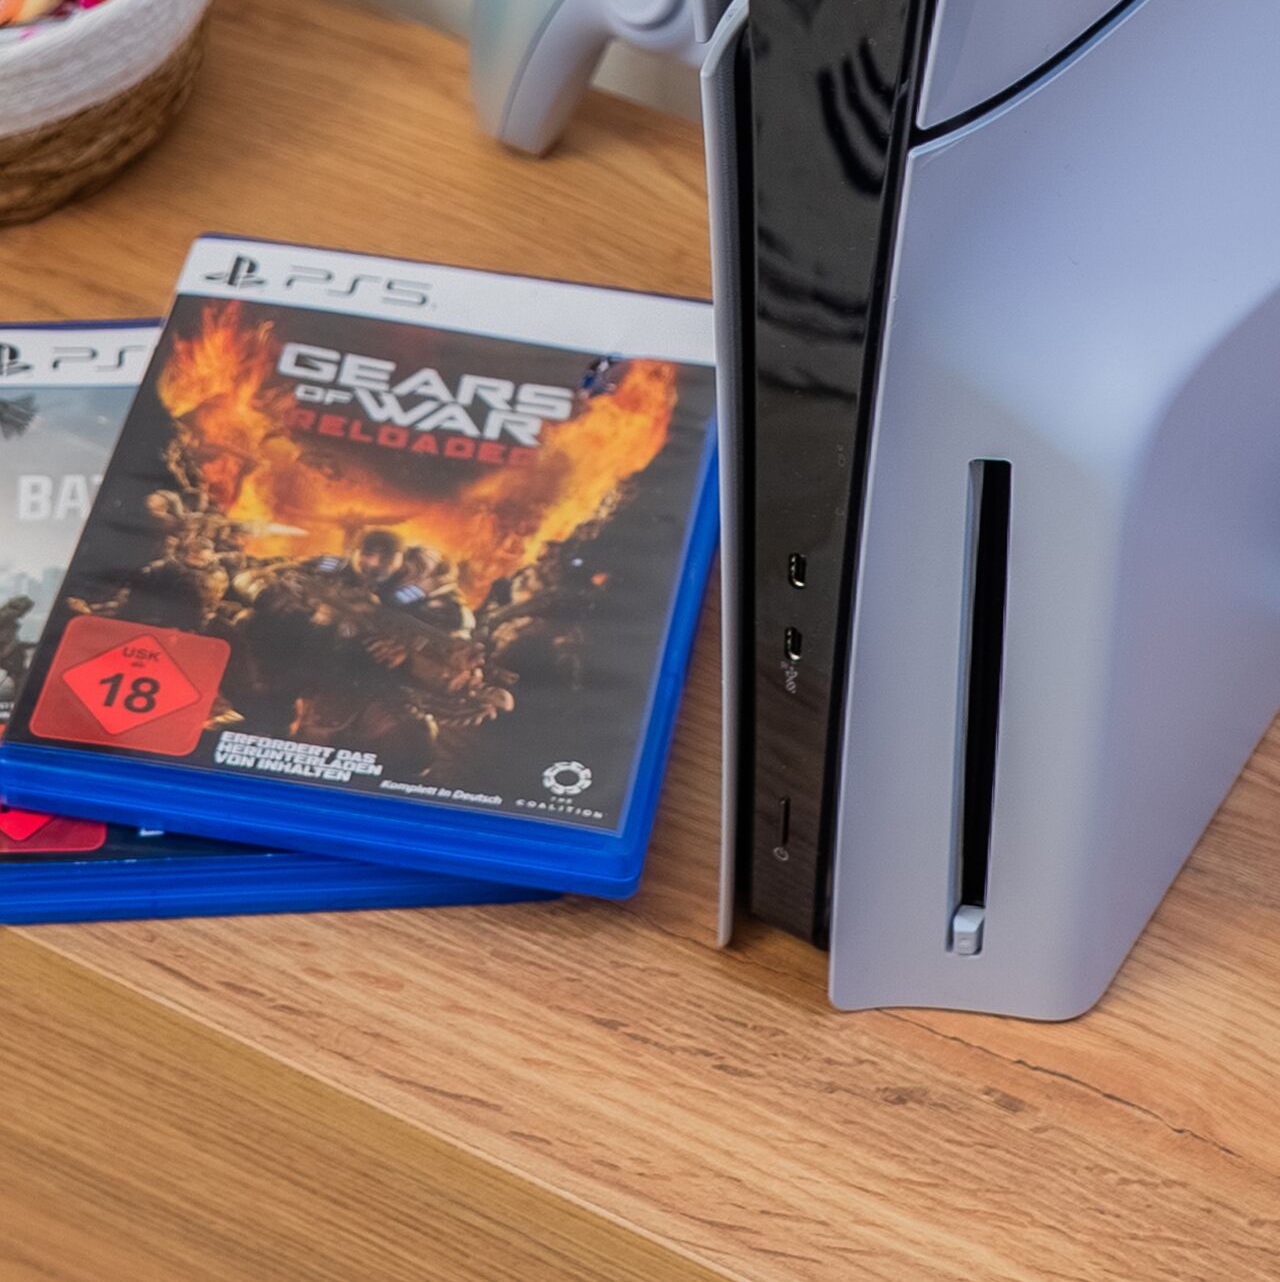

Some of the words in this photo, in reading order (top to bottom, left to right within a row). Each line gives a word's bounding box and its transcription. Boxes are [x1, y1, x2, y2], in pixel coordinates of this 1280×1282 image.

[286, 265, 432, 307] PS5
[278, 342, 573, 420] GEARS
[294, 384, 353, 405] OF
[353, 387, 542, 447] WAR
[122, 646, 160, 662] USK
[99, 673, 160, 713] 18
[217, 741, 383, 776] HERUNTERLADEN
[220, 731, 335, 758] ERFORDERT
[335, 749, 377, 763] DAS
[214, 750, 254, 768] VON
[256, 758, 352, 782] INHALTEN
[379, 779, 437, 797] Komplett
[437, 787, 451, 798] in
[451, 789, 503, 806] Deutsch
[515, 798, 603, 819] COALITION
